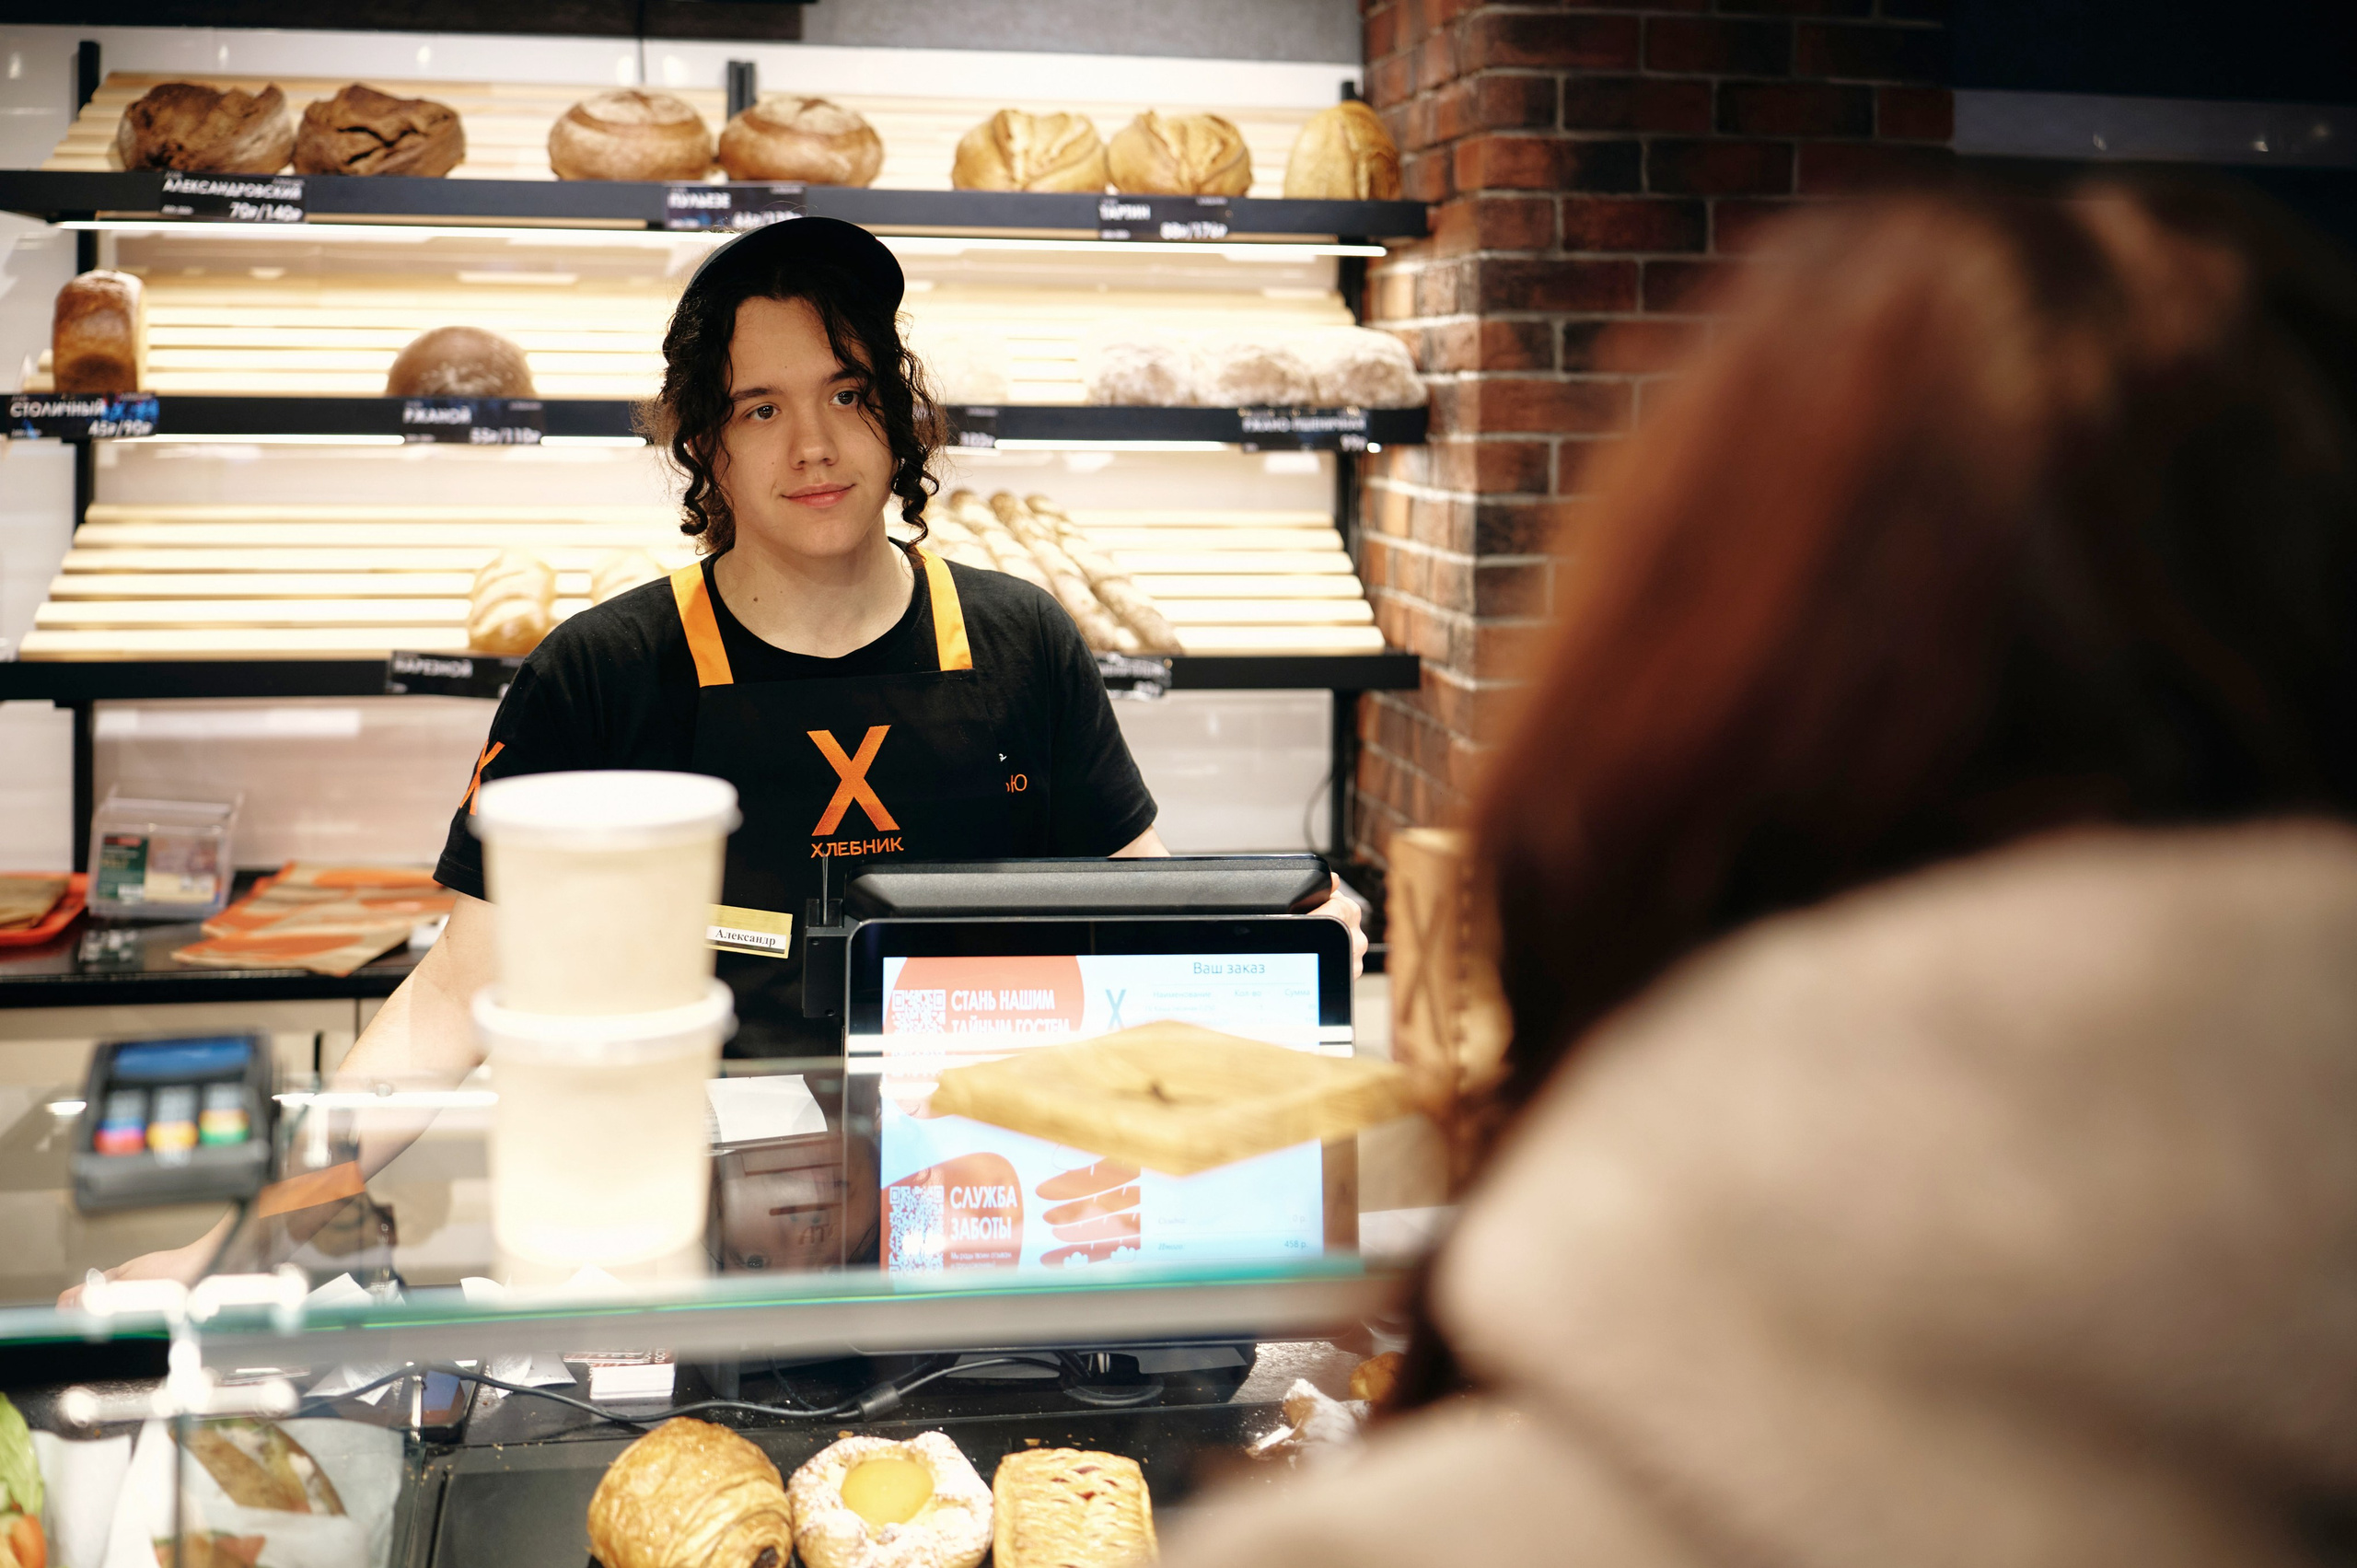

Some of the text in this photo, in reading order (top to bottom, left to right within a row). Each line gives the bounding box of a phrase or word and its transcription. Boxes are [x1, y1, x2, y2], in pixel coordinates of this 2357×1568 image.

[9, 398, 107, 418] СТОЛИЧНЫЙ
[810, 836, 905, 859] ХЛЕБНИК
[715, 928, 776, 947] Александр
[1193, 962, 1266, 974] Ваш заказ
[951, 989, 1055, 1011] СТАНЬ НАШИМ
[1152, 991, 1213, 999] Наименование
[1283, 988, 1311, 999] Сумма
[950, 1185, 1018, 1209] СЛУЖБА
[950, 1216, 1012, 1240] ЗАБОТЫ
[1283, 1239, 1299, 1249] 458
